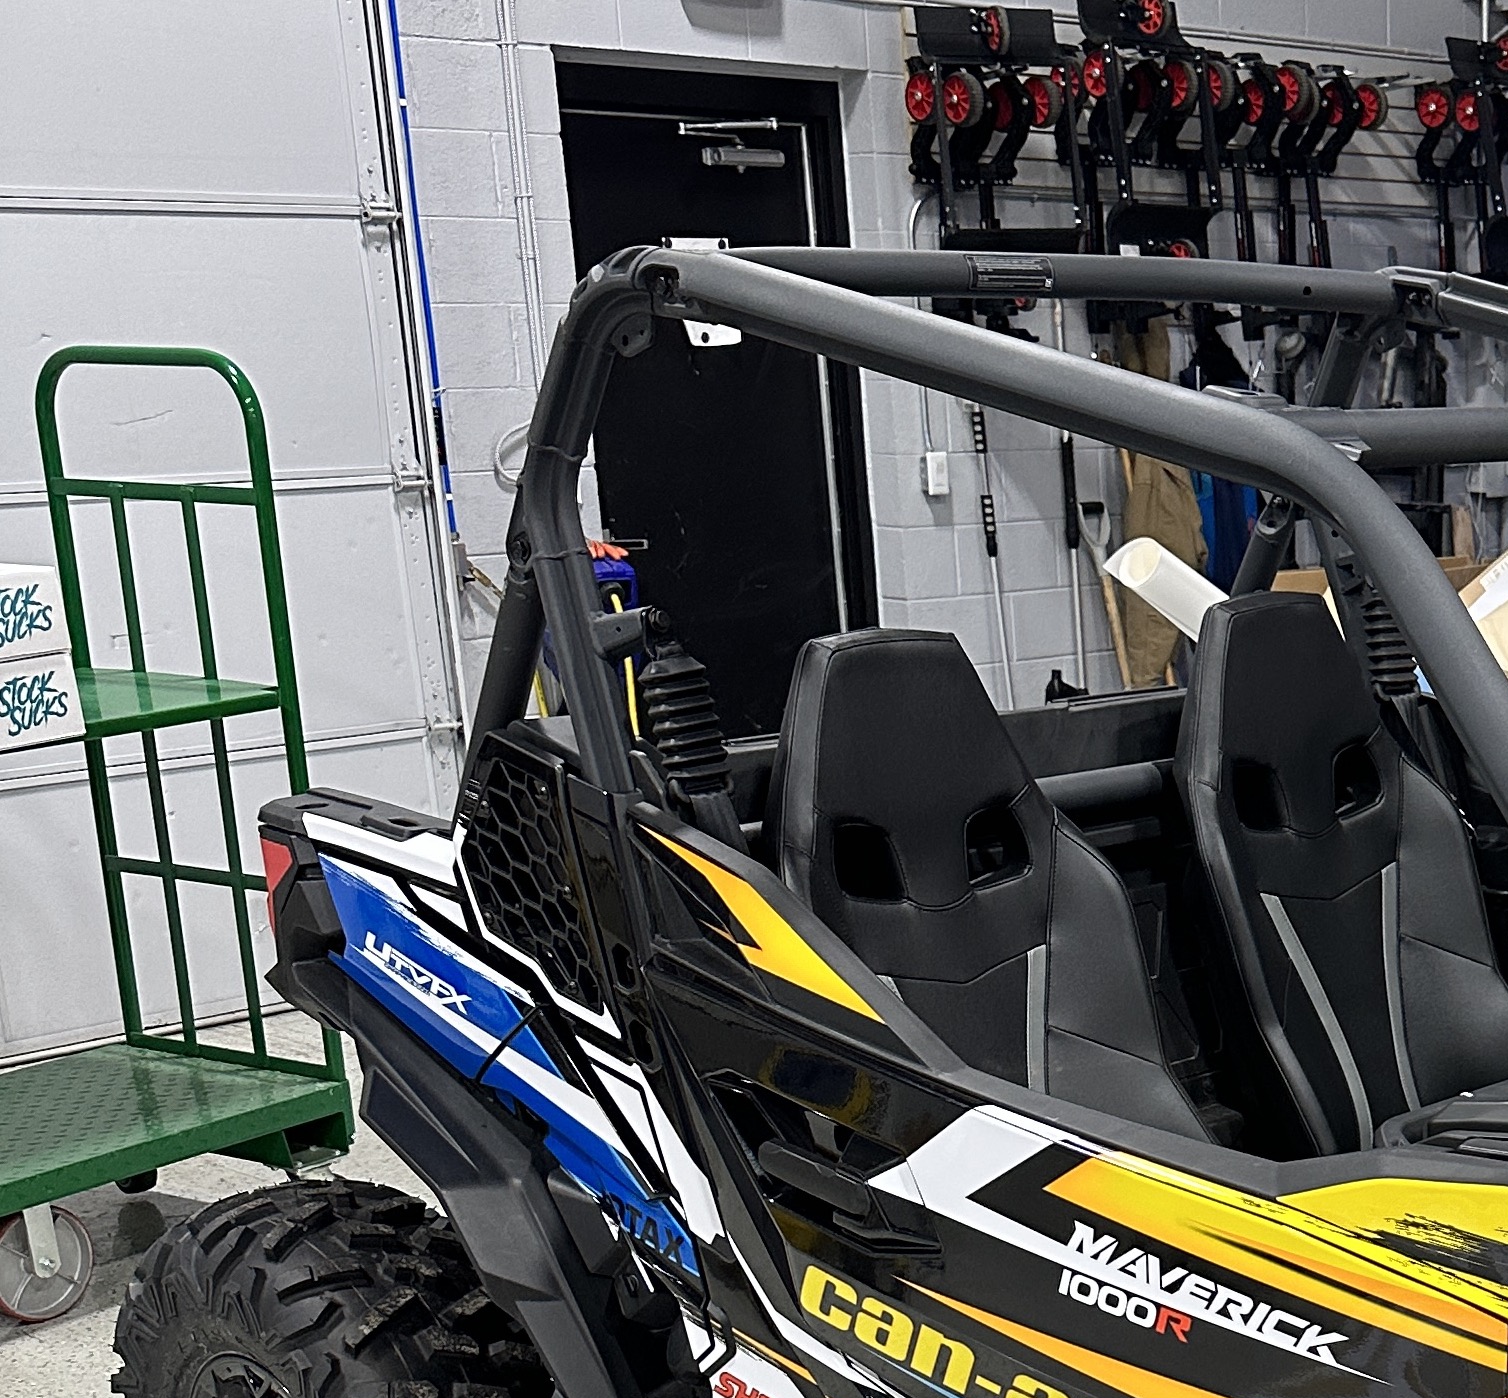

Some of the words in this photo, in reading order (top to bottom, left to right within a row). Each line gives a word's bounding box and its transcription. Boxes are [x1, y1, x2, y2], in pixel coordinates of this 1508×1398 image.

[0, 670, 60, 717] STOCK
[8, 691, 69, 737] SUCKS
[1057, 1269, 1192, 1345] 1000R
[1066, 1219, 1351, 1366] MAVERICK
